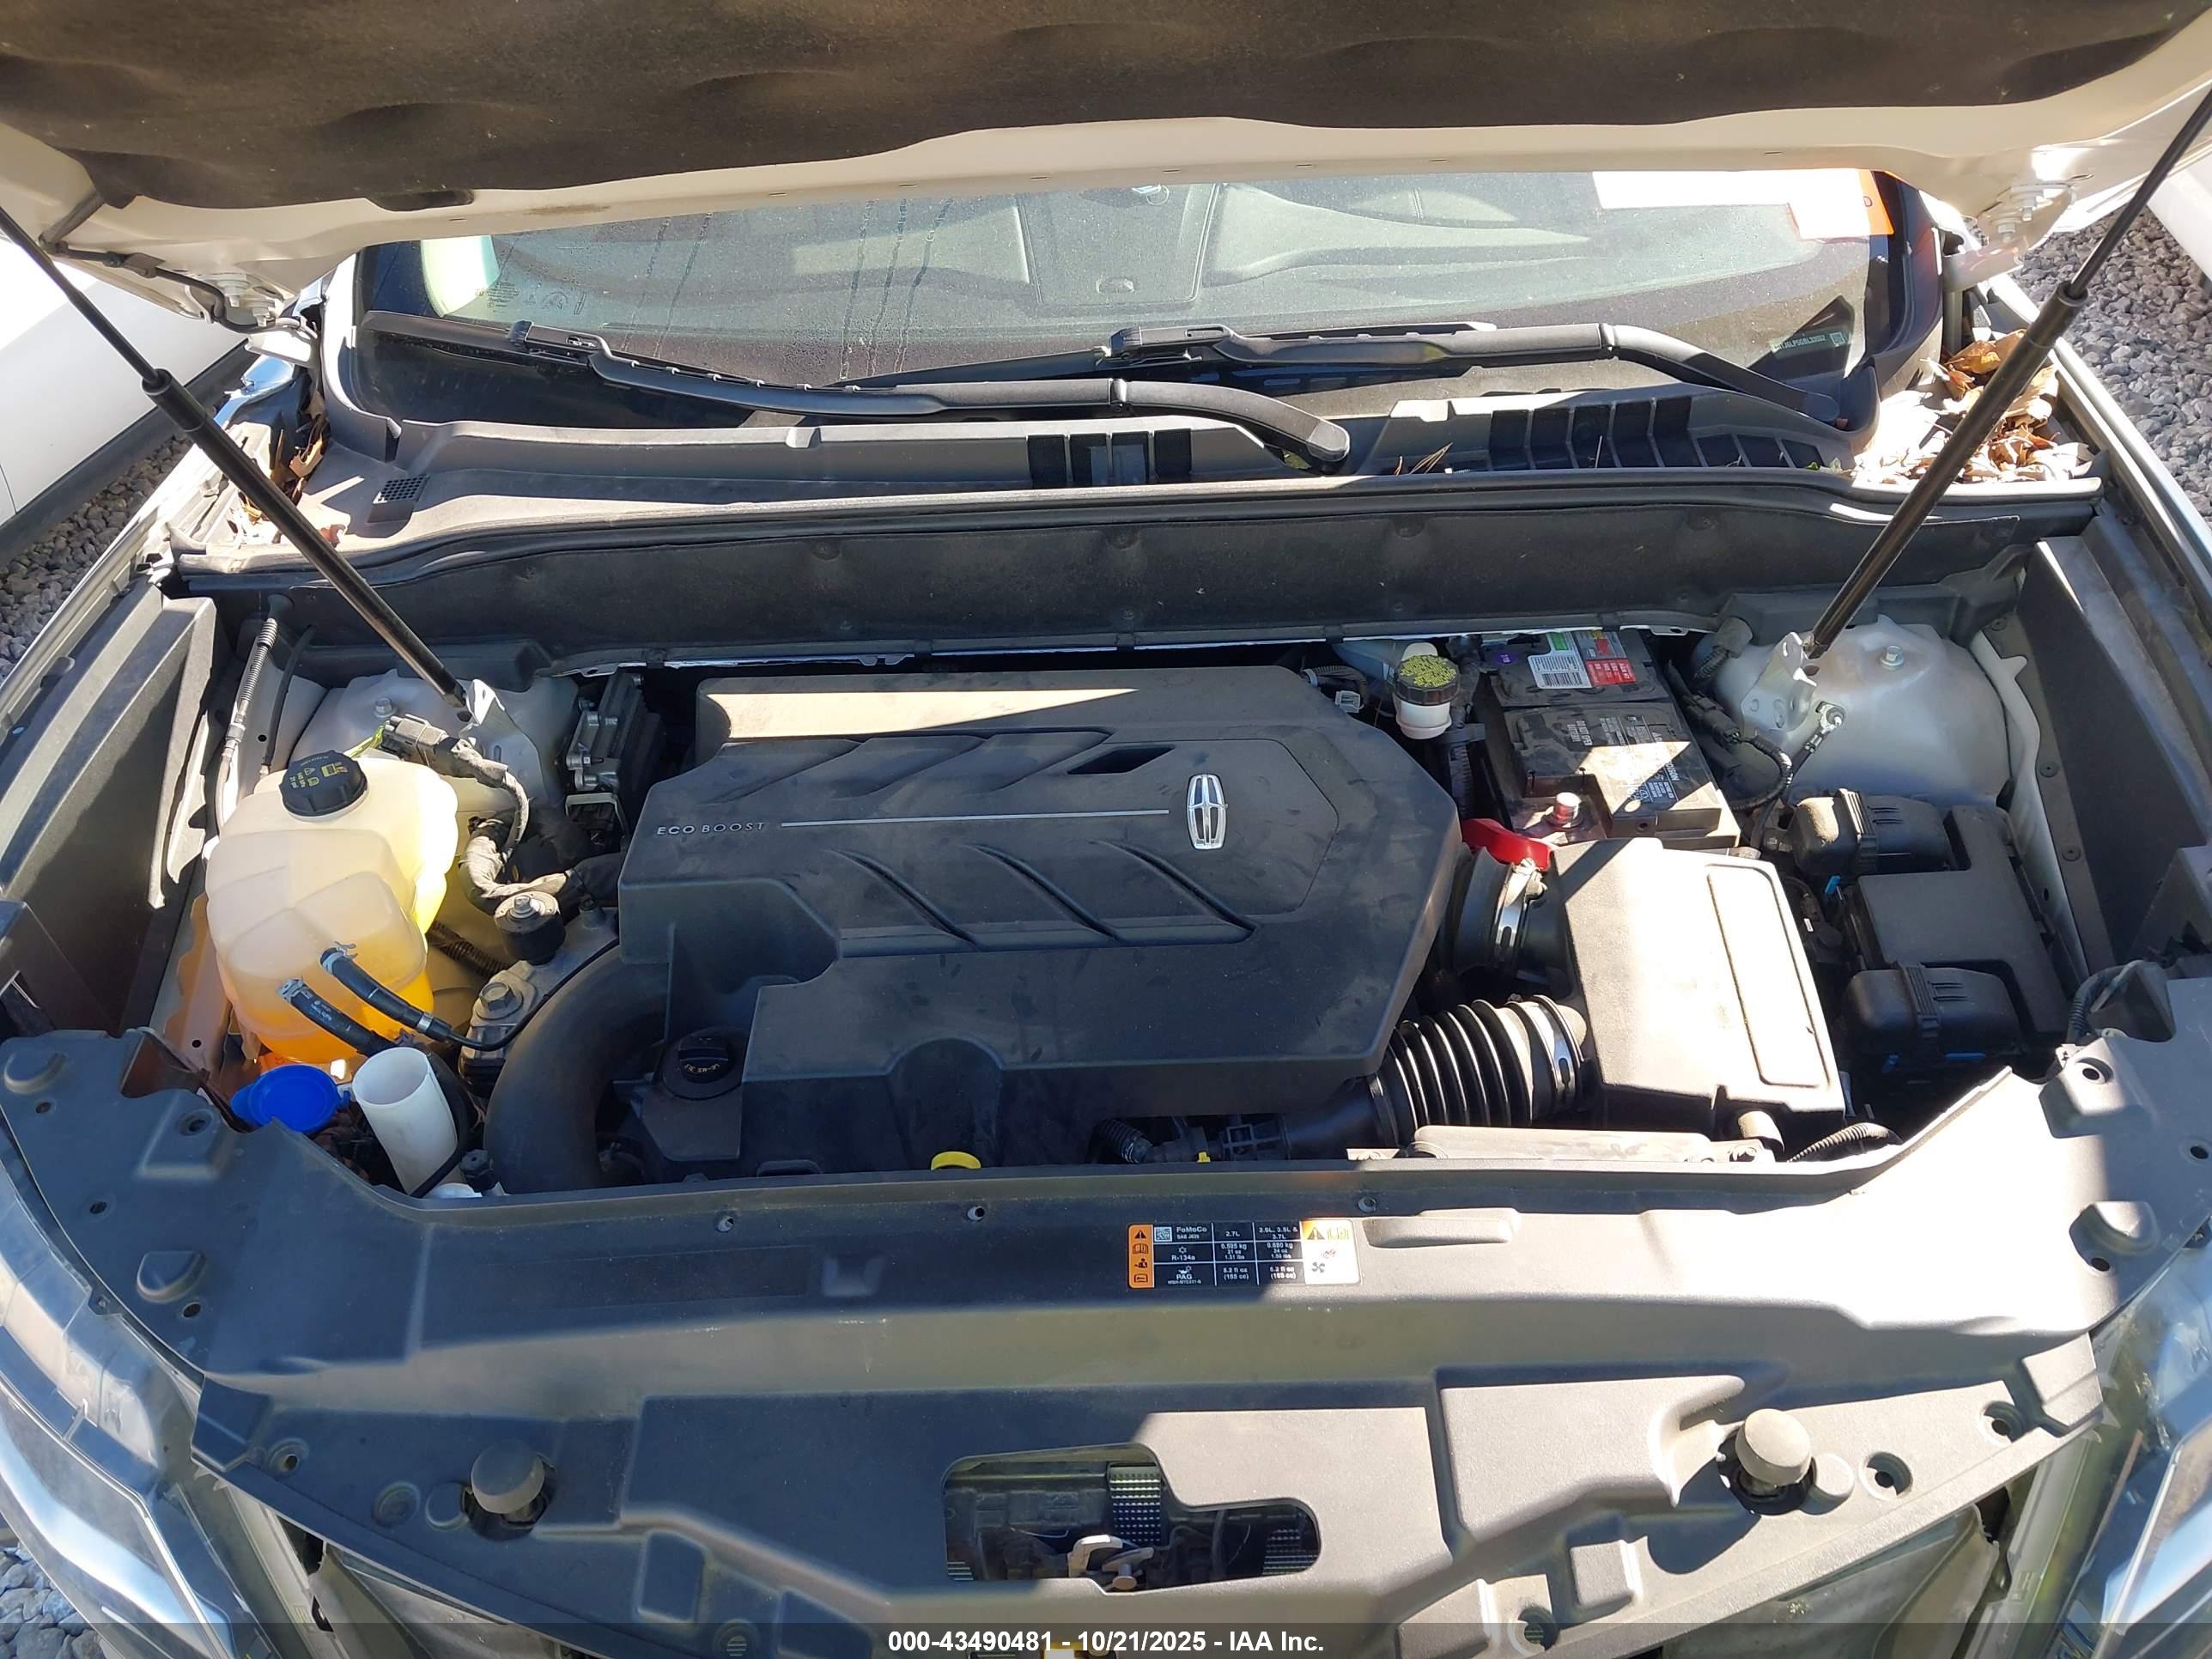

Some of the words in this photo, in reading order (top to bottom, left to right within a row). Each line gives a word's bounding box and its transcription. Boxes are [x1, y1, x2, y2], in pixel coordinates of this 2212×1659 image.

[1665, 762, 1680, 781] OISON
[657, 825, 696, 835] ECO
[702, 822, 765, 833] BOOST
